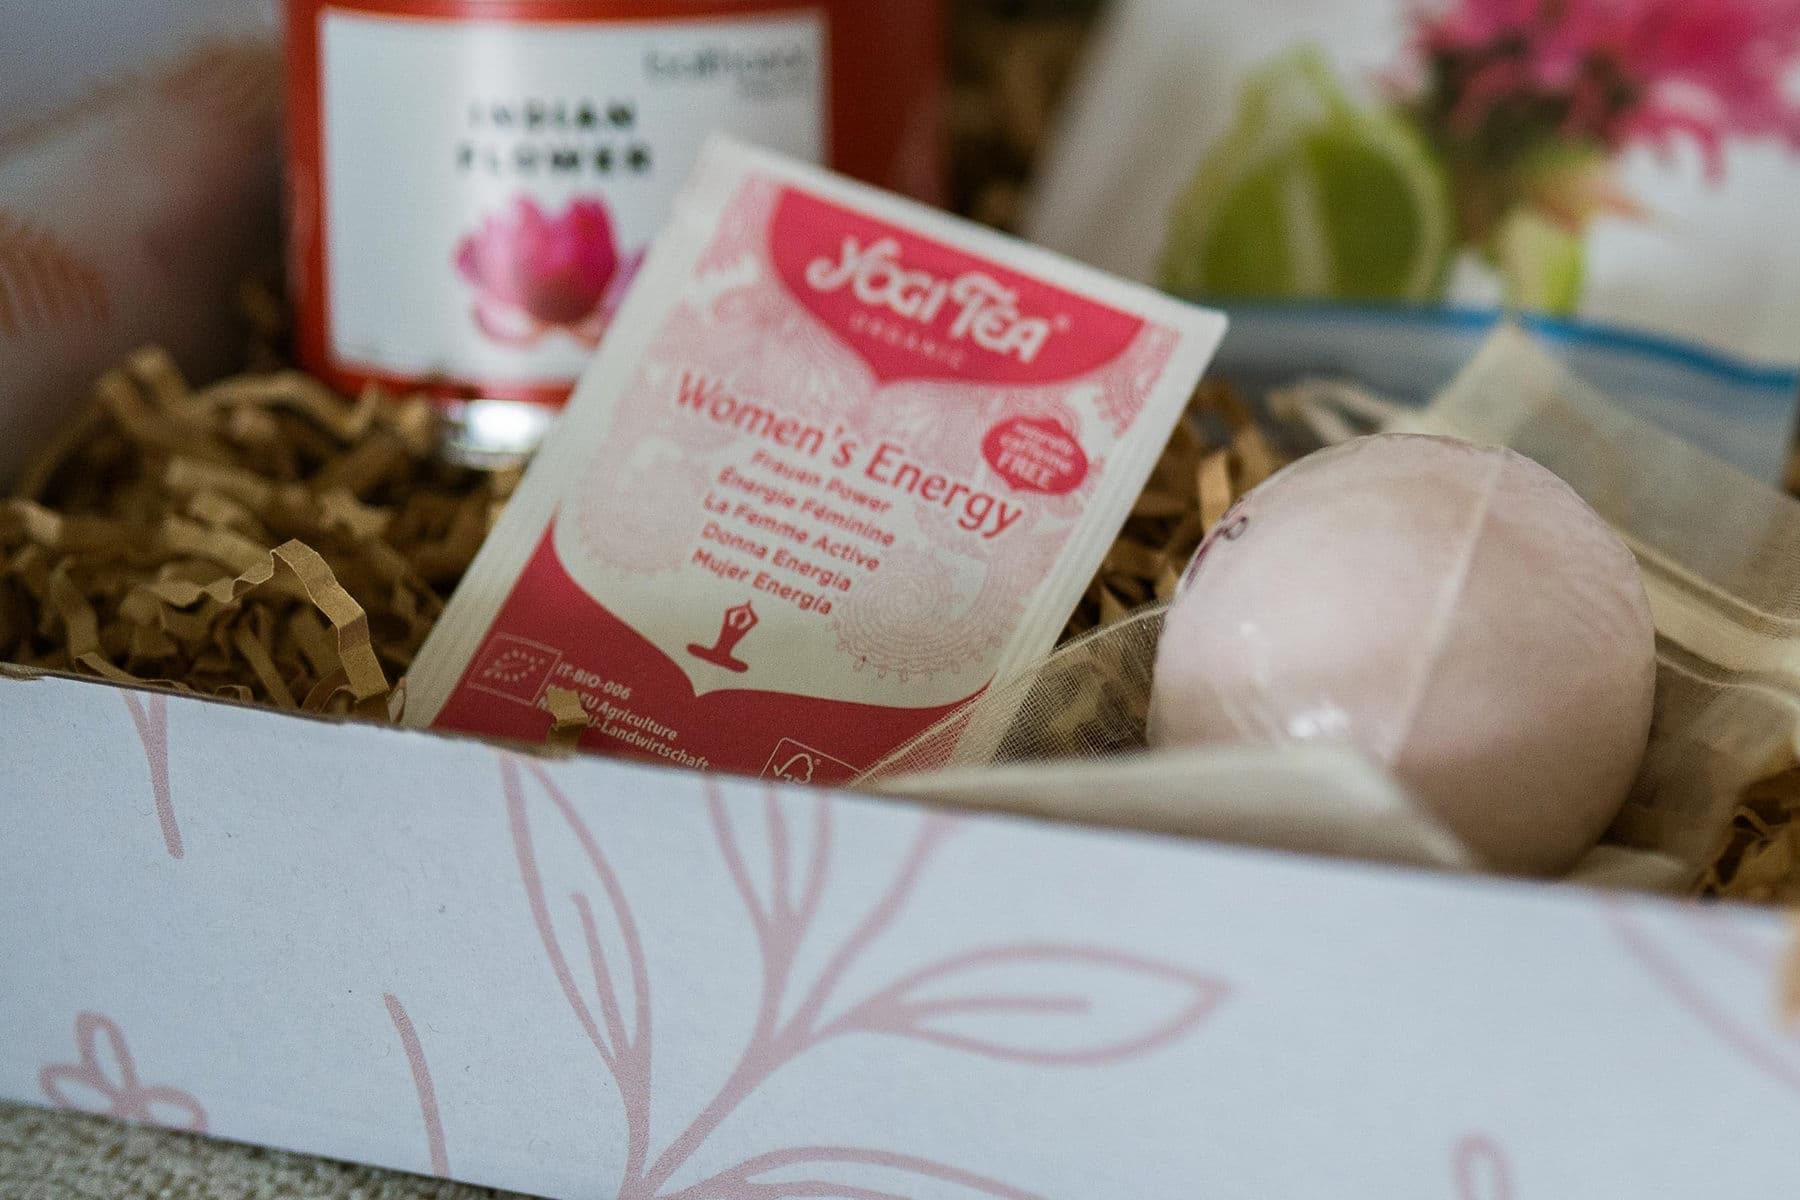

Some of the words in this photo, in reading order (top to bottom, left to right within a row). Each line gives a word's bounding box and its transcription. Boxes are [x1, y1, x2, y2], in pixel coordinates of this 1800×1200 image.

[467, 100, 637, 130] INDIAN
[456, 143, 652, 174] FLOWER
[677, 370, 858, 468] Women's
[864, 441, 1023, 540] Energy
[751, 449, 823, 487] Frauen
[825, 477, 893, 513] Power
[701, 520, 769, 560] Donna
[702, 491, 730, 515] La
[733, 502, 809, 544] Femme
[812, 534, 880, 572] Active
[690, 547, 750, 581] Mujer
[556, 662, 632, 700] IT-BIO-006
[597, 701, 679, 741] Agriculture
